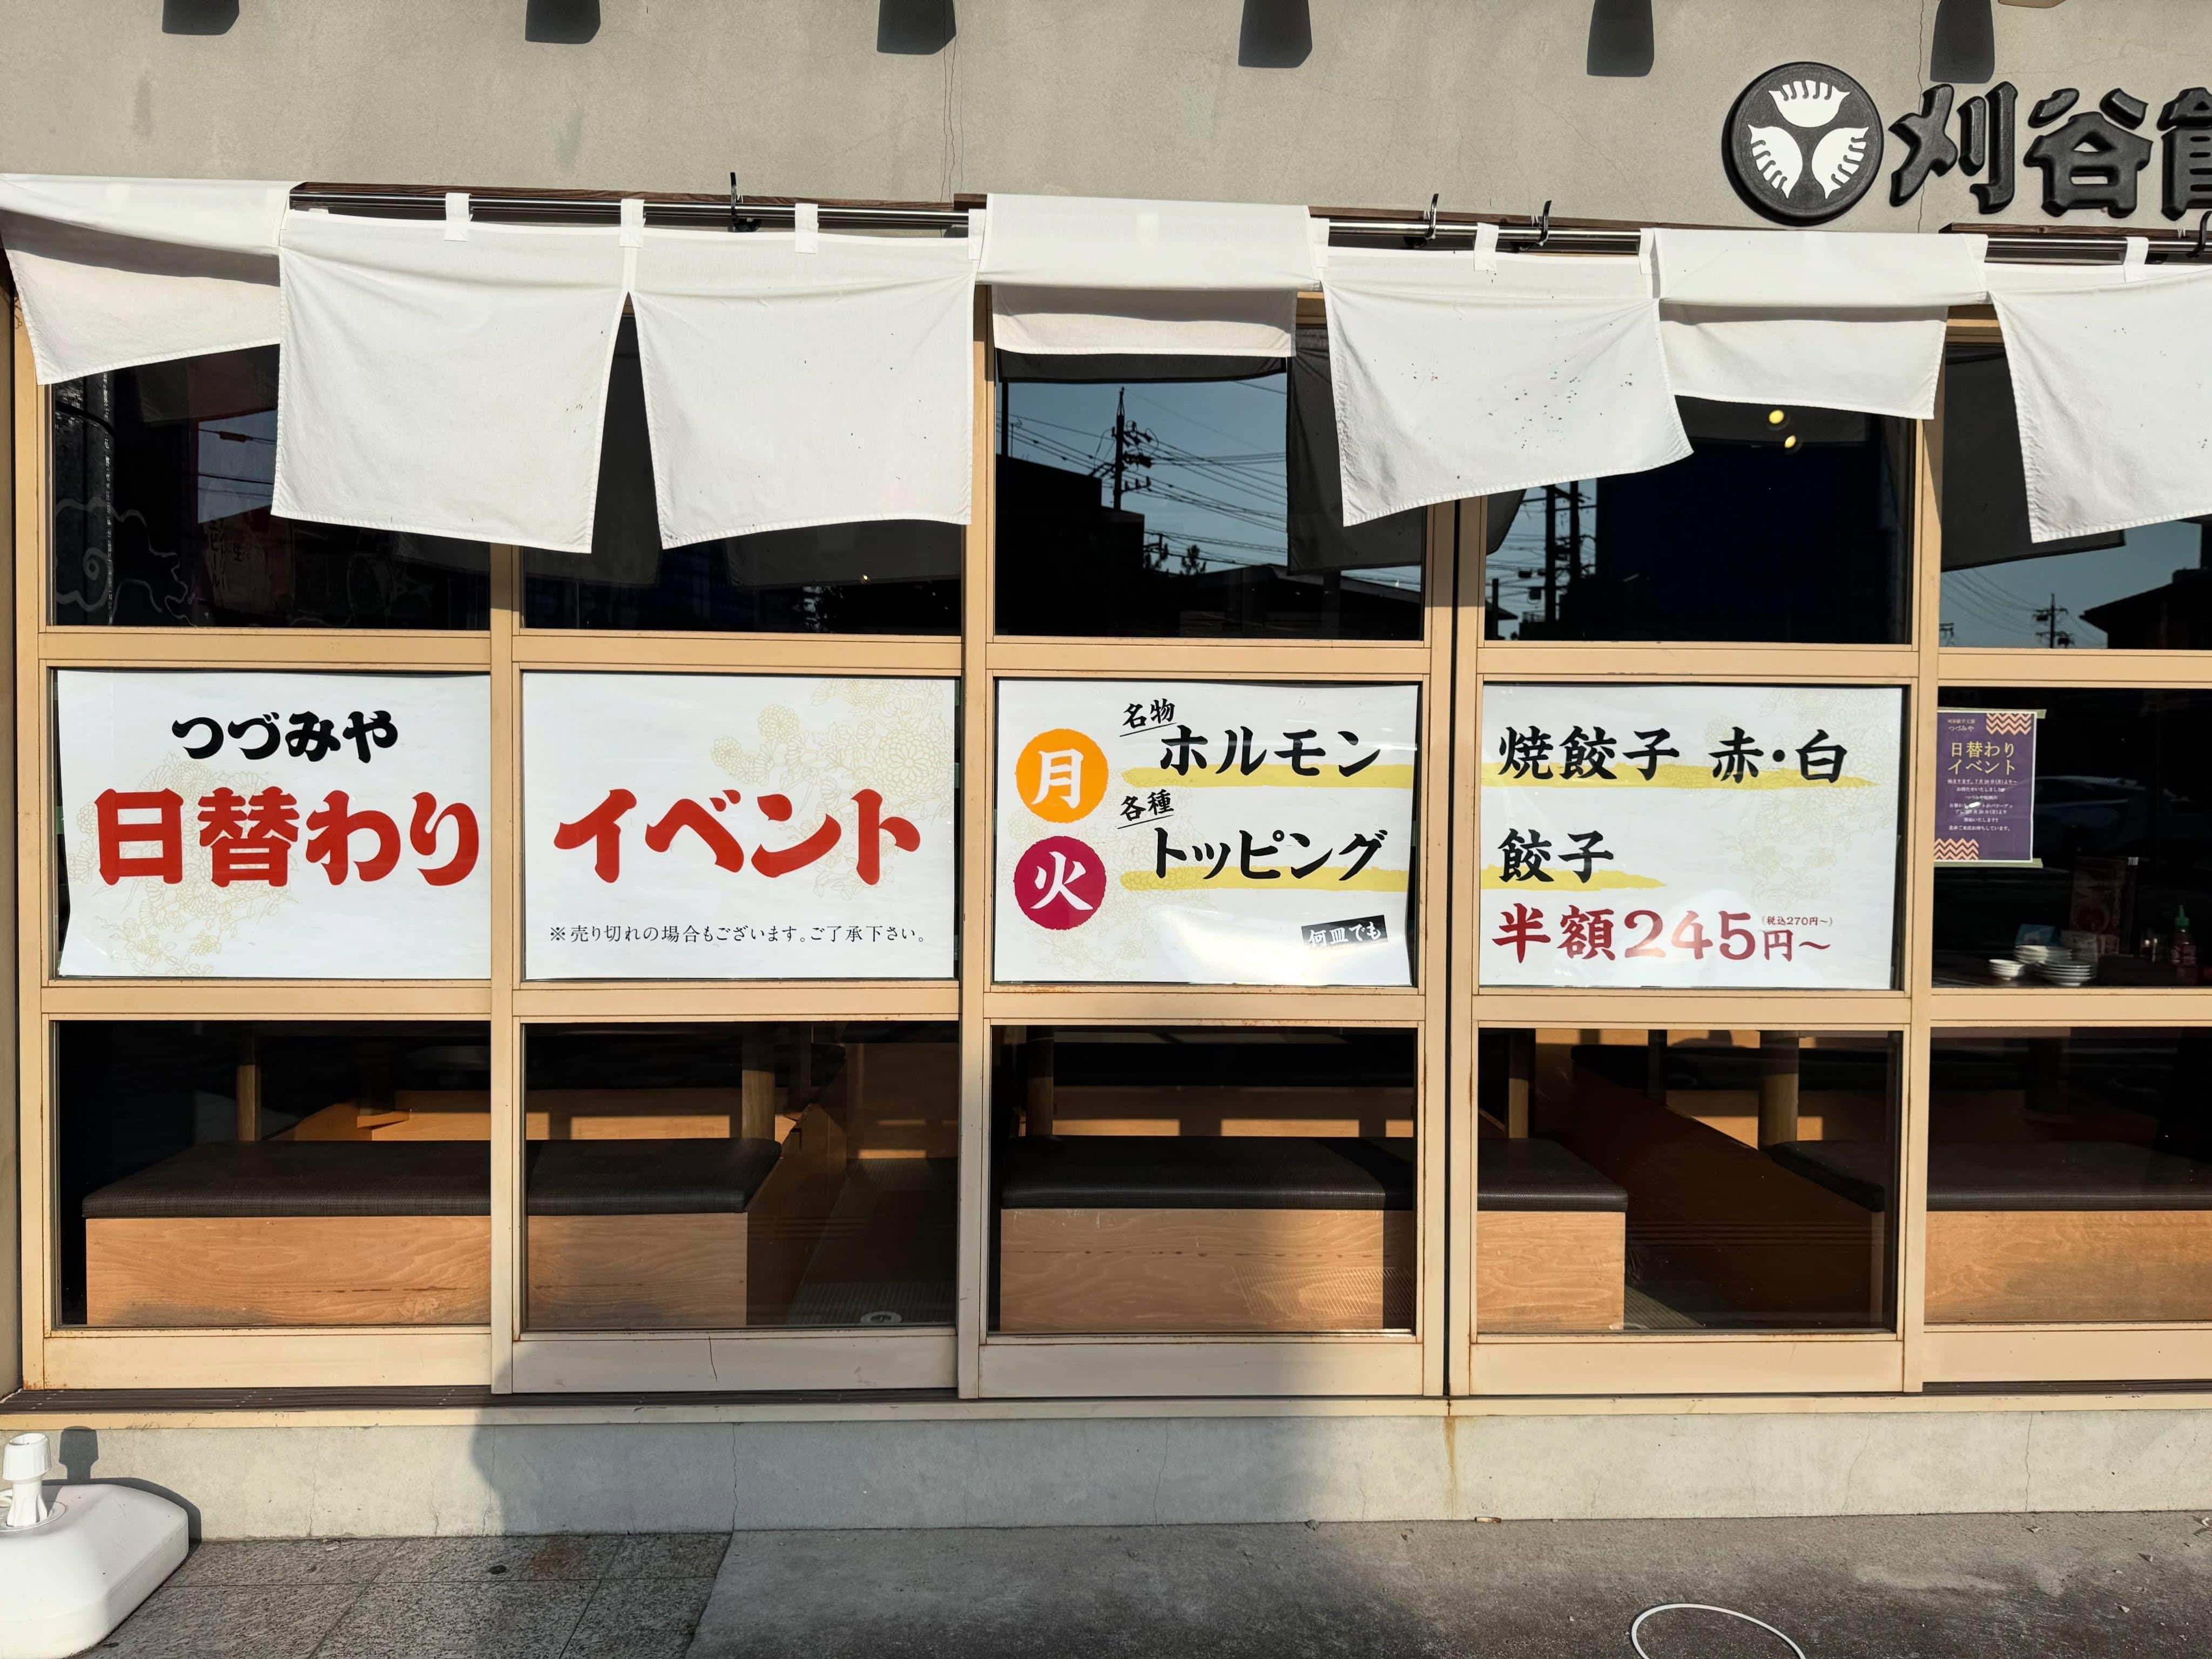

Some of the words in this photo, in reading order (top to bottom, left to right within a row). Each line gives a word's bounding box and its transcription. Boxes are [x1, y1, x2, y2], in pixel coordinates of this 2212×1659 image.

[172, 711, 398, 763] つづみや
[1122, 699, 1176, 728] 名物
[1159, 725, 1381, 777] ホルモン
[1498, 725, 1680, 781] 焼餃子
[1708, 726, 1847, 784] 赤・白
[1948, 759, 2015, 775] イベント
[1951, 740, 2014, 758] 日替わり
[1032, 748, 1084, 808] 月
[1121, 789, 1175, 822] 各種
[95, 786, 480, 888] 日替わり
[554, 788, 921, 886] イベント
[1154, 827, 1388, 881] トッピング
[1498, 828, 1614, 883] 餃子
[1031, 851, 1093, 911] 火
[550, 924, 925, 944] ※売り切れの場合もございます。ご了承下さい。
[1309, 921, 1381, 946] 何皿でも
